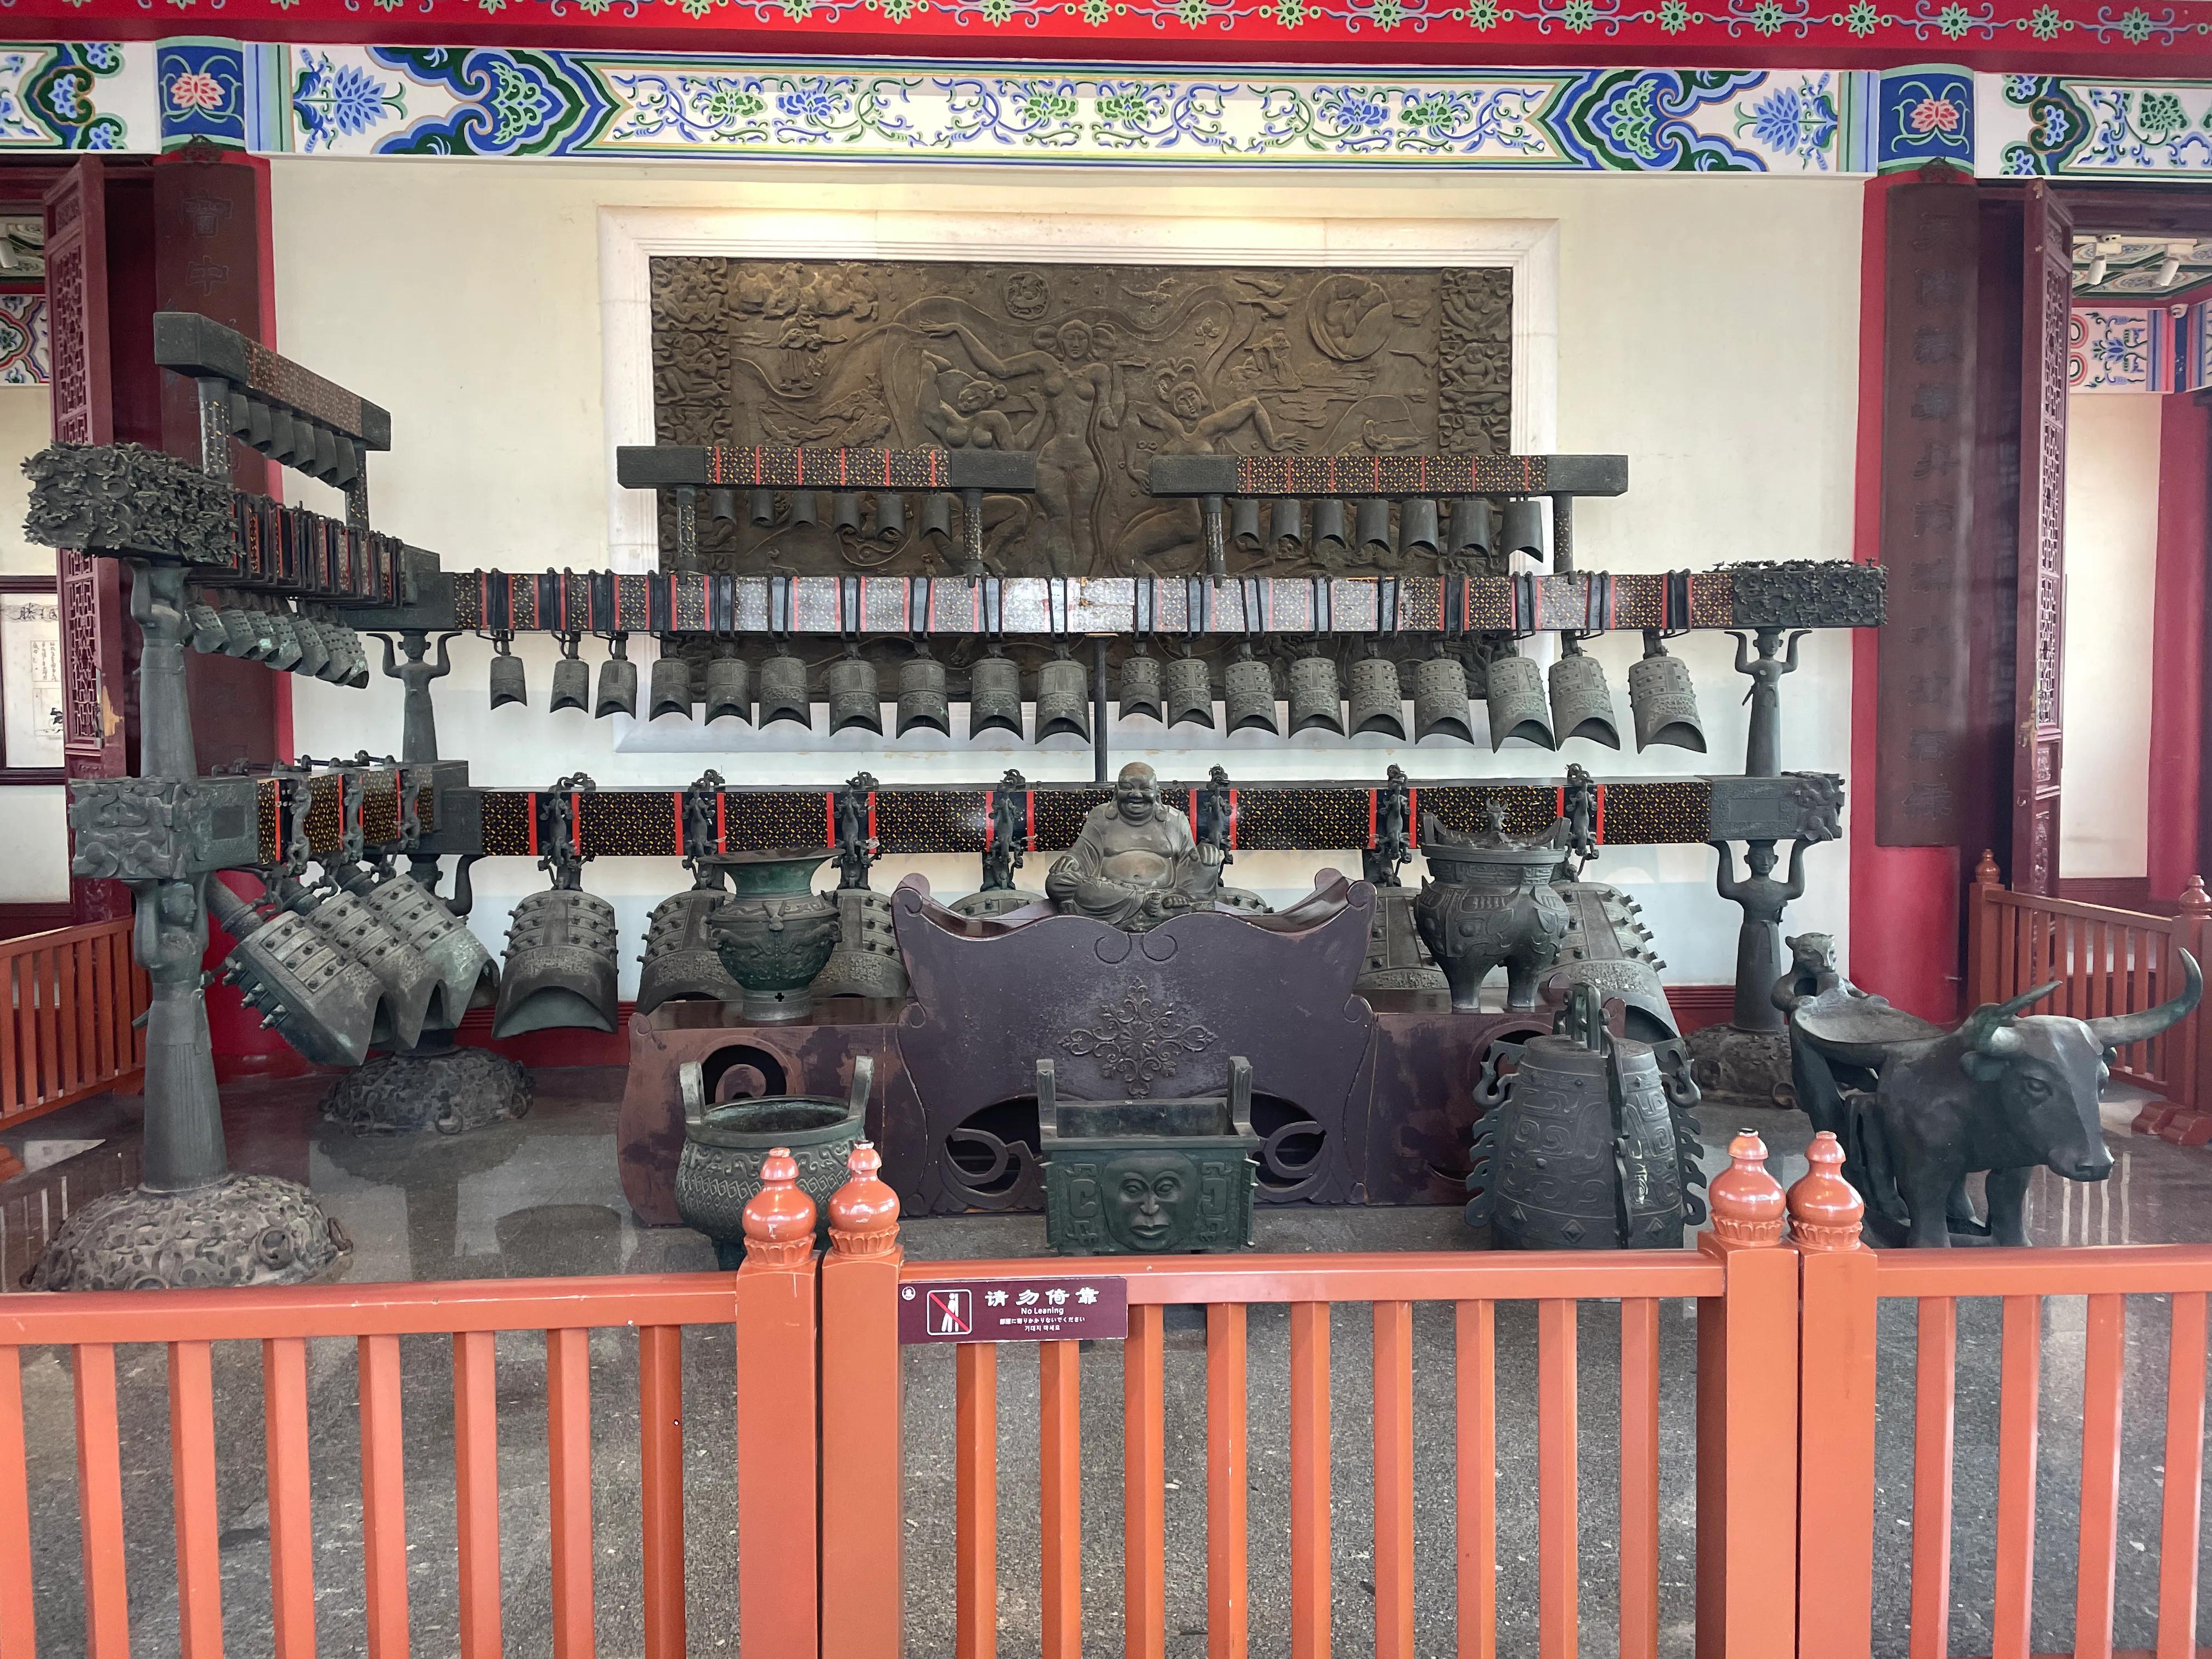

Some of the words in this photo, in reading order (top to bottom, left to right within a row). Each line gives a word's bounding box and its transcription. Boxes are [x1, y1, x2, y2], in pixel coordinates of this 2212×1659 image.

[984, 1287, 1099, 1307] 请勿倚靠
[1034, 1307, 1064, 1316] Leaning
